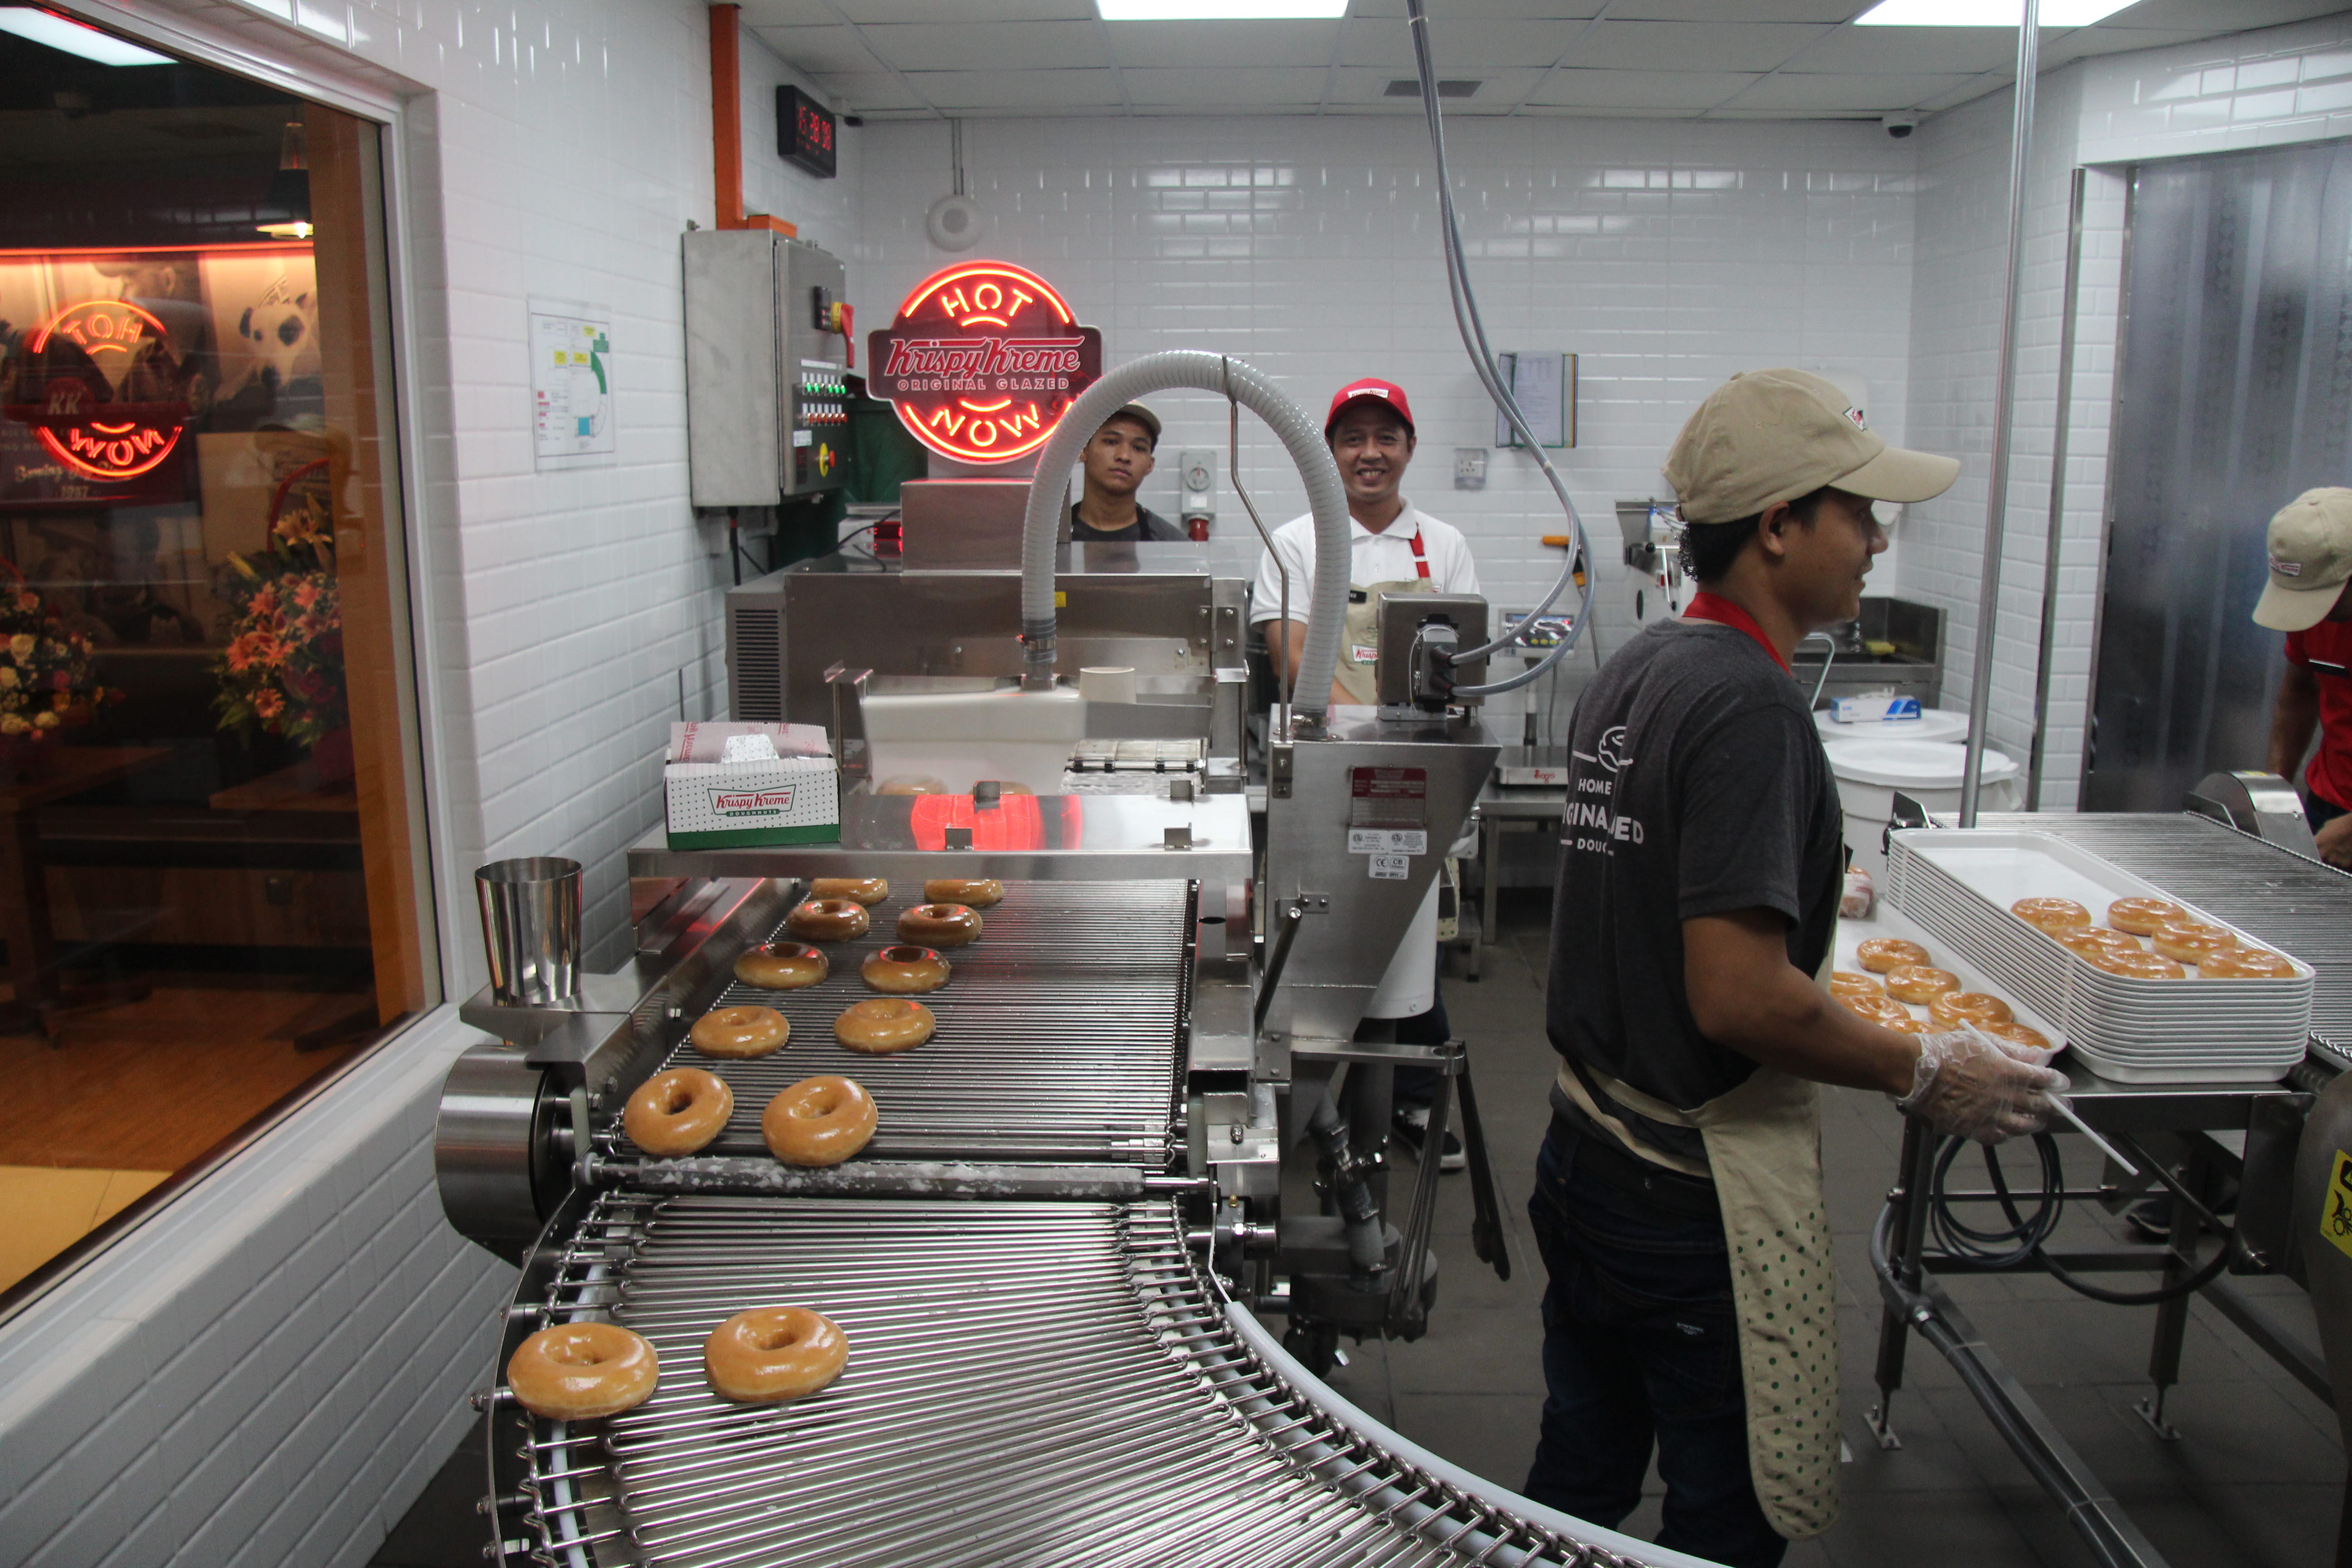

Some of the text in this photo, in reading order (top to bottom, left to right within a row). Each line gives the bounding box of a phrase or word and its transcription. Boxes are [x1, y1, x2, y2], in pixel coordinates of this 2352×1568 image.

[941, 283, 1034, 317] HOT
[884, 337, 1085, 379] Krispy Kreme
[897, 377, 1069, 391] ORIGINAL GLAZED
[930, 403, 1040, 447] NOW
[1578, 778, 1612, 795] HOME
[716, 792, 791, 810] Krispy Kreme
